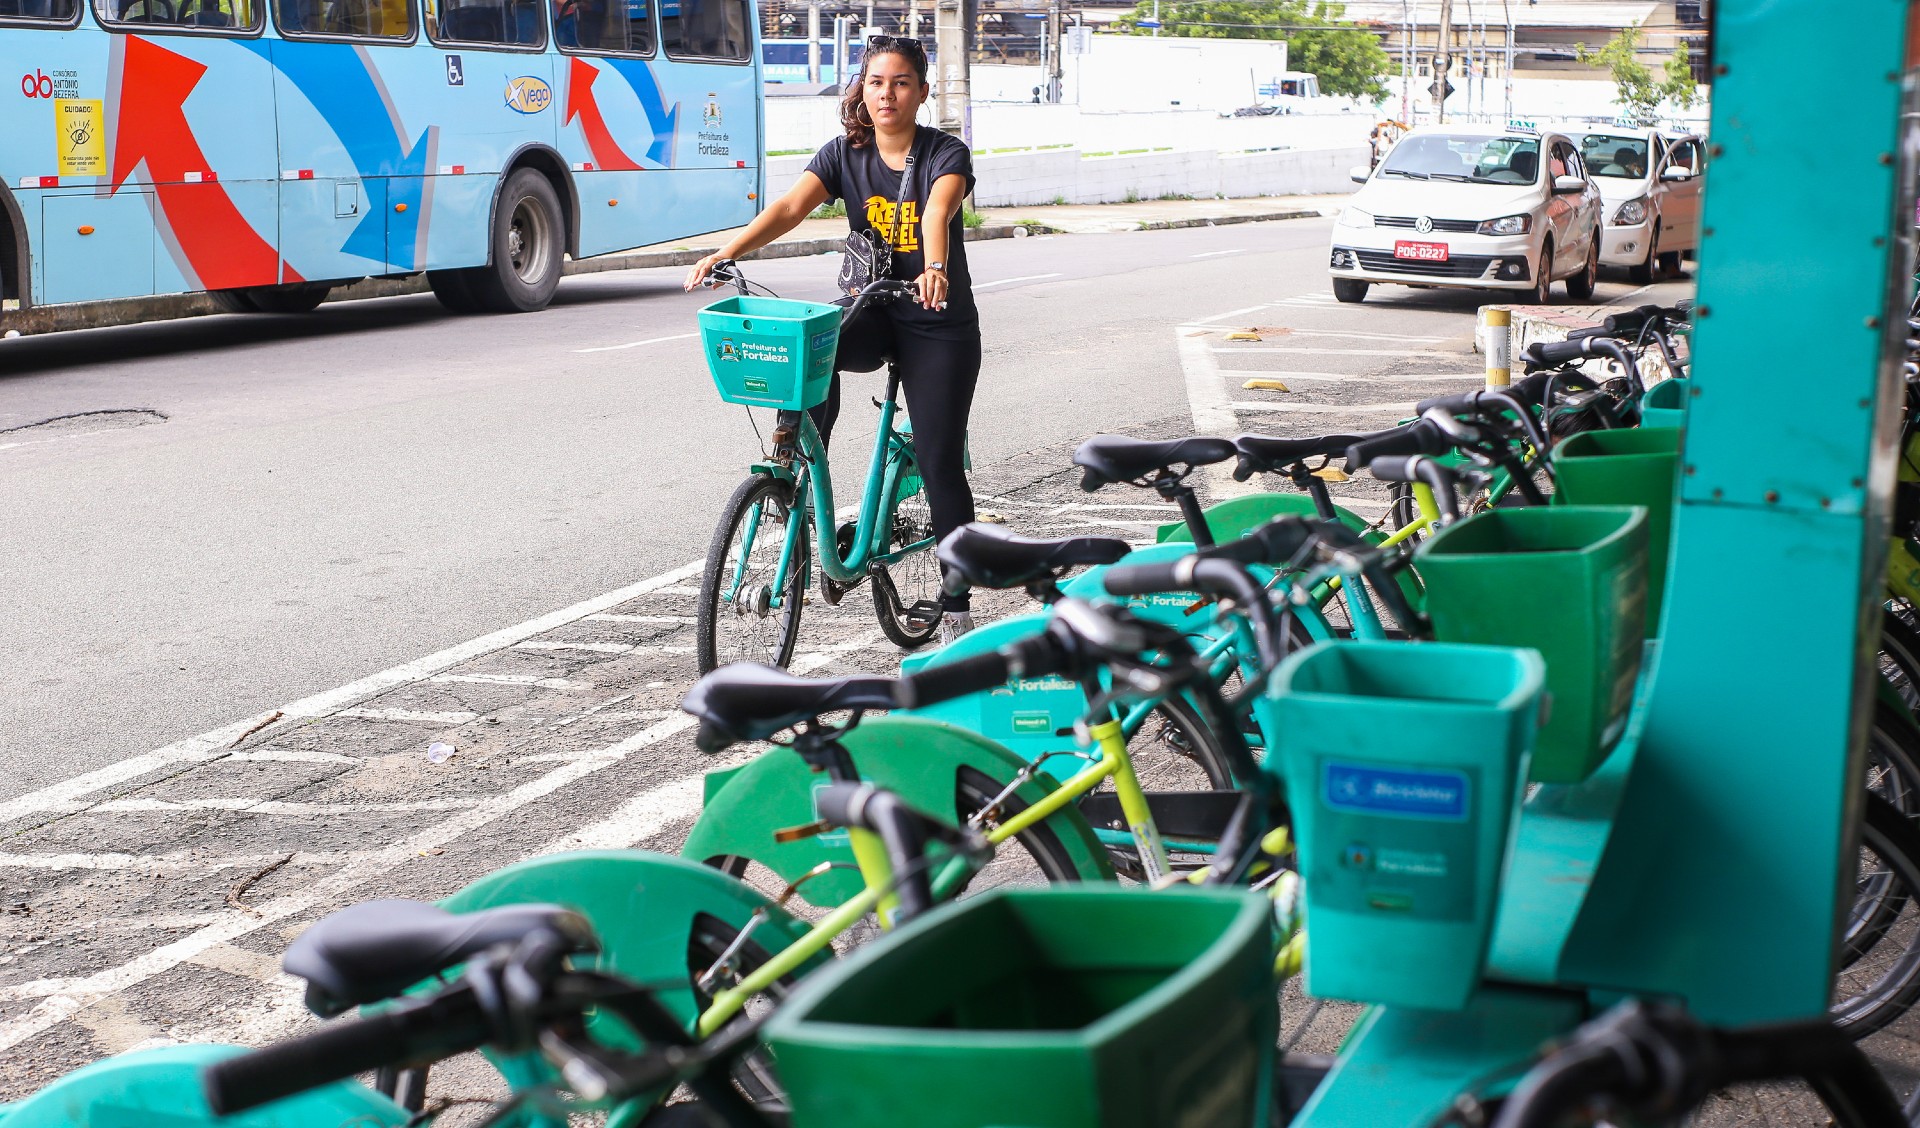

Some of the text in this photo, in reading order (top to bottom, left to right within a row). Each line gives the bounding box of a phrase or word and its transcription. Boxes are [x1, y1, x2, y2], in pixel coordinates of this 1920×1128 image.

[53, 69, 77, 77] CONSÓRCIO
[54, 78, 78, 89] ANTÔNIO
[54, 90, 79, 99] BEZERRA
[522, 88, 548, 107] Vega
[1509, 119, 1535, 128] TAXI
[698, 131, 729, 141] Prefeitura de
[698, 142, 729, 155] Fortaleza
[741, 342, 788, 353] Prefeitura de
[742, 350, 789, 363] Fortaleza
[1153, 595, 1198, 607] Fortalez
[1018, 677, 1076, 692] Fortaleza
